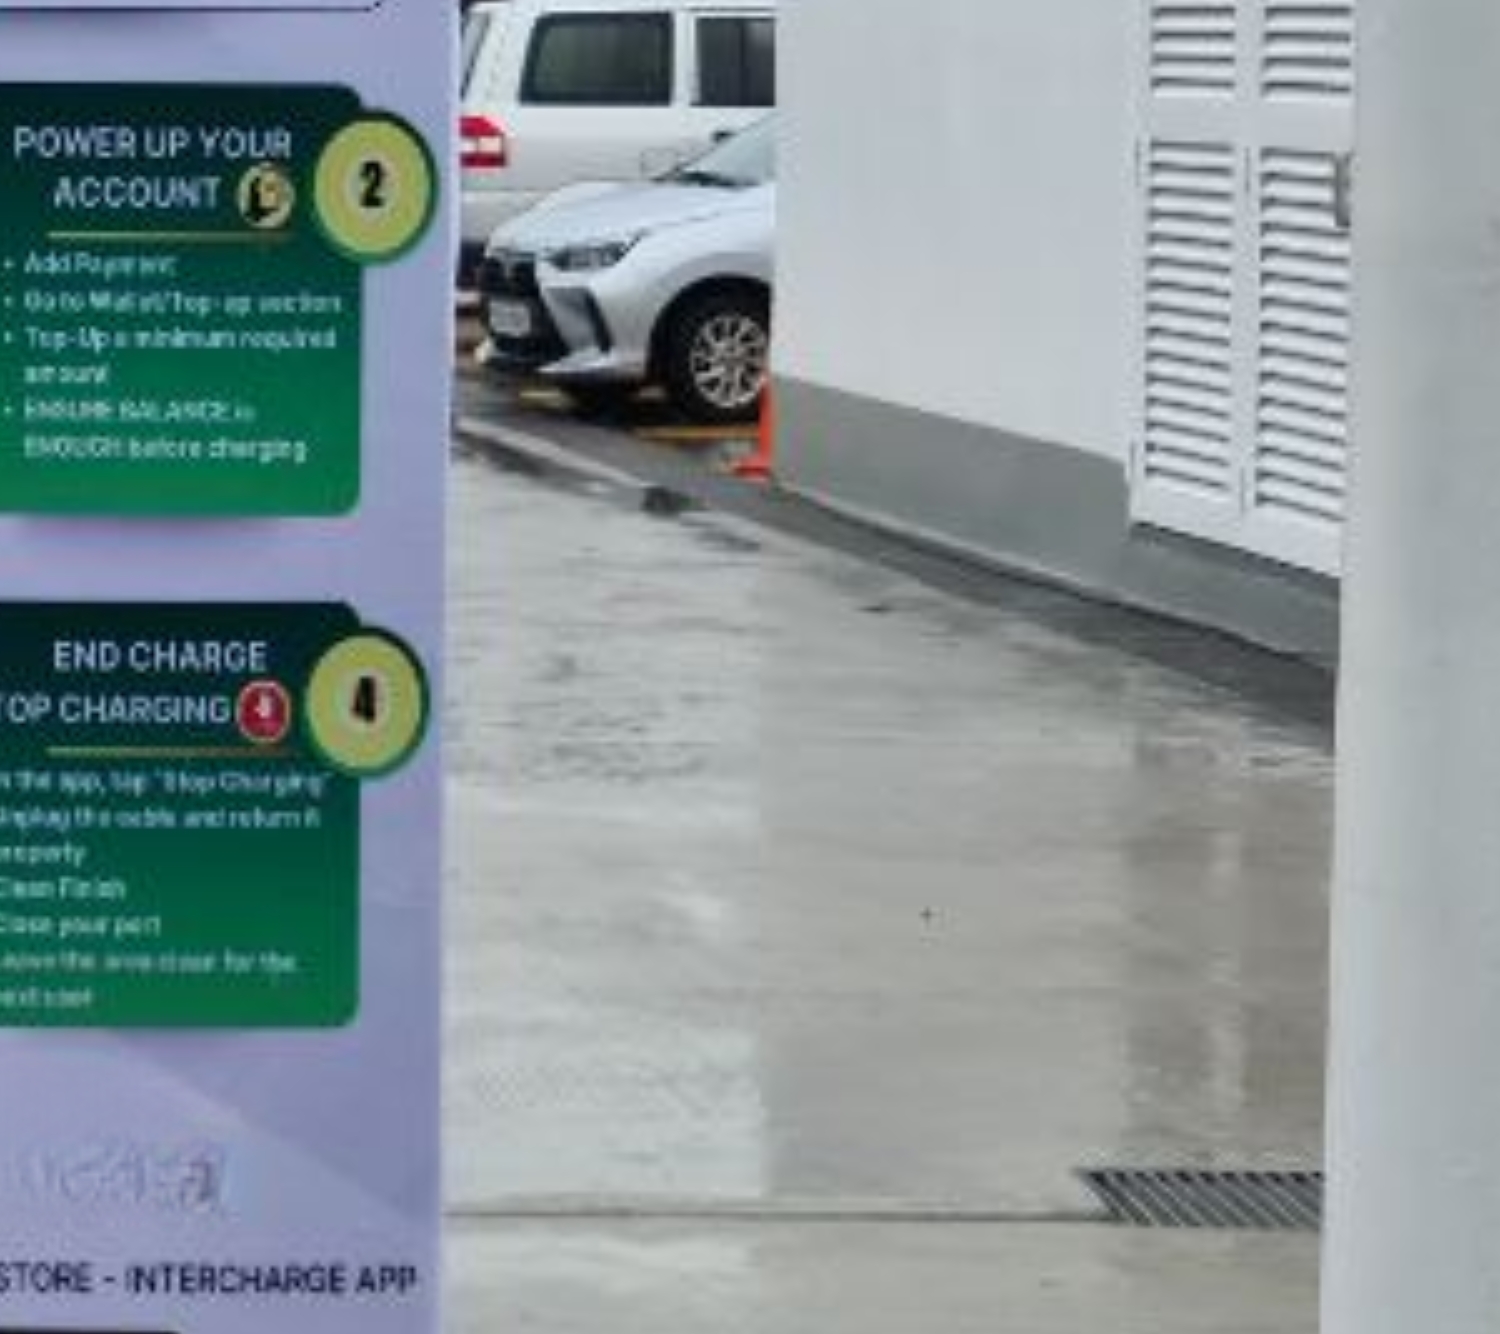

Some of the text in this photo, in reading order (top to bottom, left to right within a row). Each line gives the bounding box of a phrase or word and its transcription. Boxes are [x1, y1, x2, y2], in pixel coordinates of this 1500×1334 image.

[13, 126, 293, 159] POWER UP YOUR
[53, 176, 223, 208] ACCOUNT
[360, 161, 384, 207] 2
[24, 251, 71, 273] Add
[52, 641, 267, 673] END CHARGE
[58, 694, 231, 725] CHARGING
[350, 675, 377, 724] 4
[183, 807, 227, 828] and
[125, 1264, 346, 1295] INTERCHARGE
[355, 1265, 417, 1295] APP
